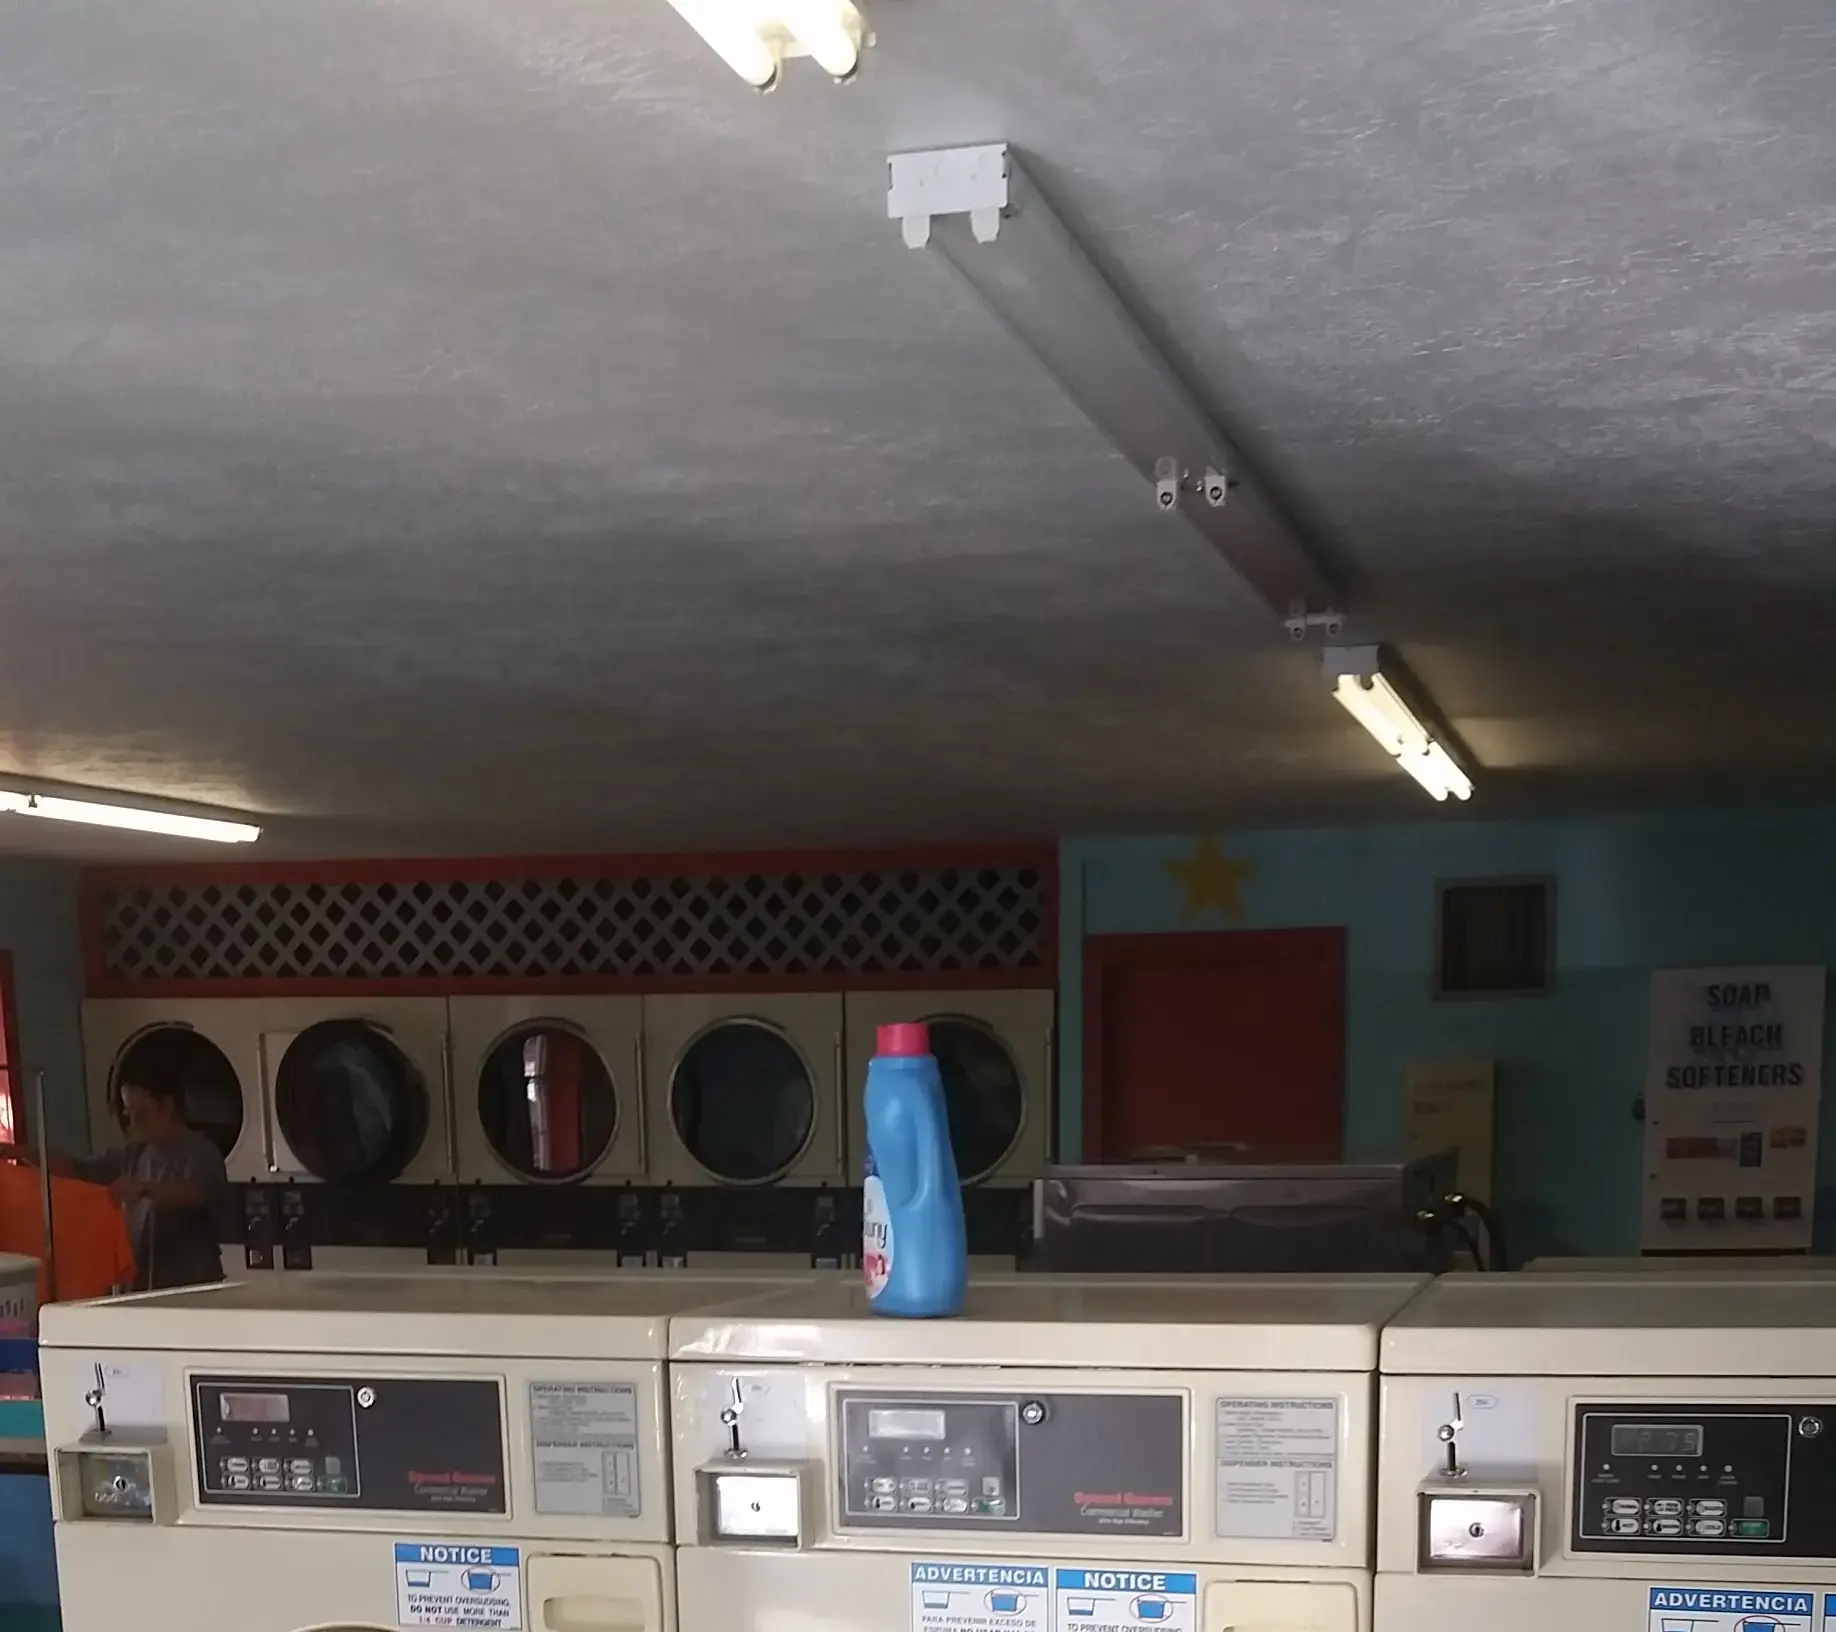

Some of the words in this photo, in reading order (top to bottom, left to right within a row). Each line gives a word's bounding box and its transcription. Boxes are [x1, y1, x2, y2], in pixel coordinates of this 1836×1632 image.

[1707, 983, 1770, 1007] SOAP
[1691, 1023, 1782, 1047] BLEACH
[1665, 1063, 1805, 1089] SOFTENERS
[420, 1546, 492, 1564] NOTICE
[915, 1566, 1044, 1584] ADVERTENCIA
[1084, 1572, 1166, 1590] NOTICE
[420, 1594, 453, 1604] PREVENT
[1654, 1592, 1808, 1612] ADVERTENCIA
[425, 1606, 442, 1614] NOT
[444, 1606, 459, 1614] USE
[464, 1607, 484, 1615] MORE
[489, 1608, 509, 1617] THAN
[456, 1618, 503, 1627] DETERGENT
[946, 1616, 987, 1625] PREVENIR
[989, 1618, 1022, 1627] EXCESO
[1025, 1620, 1036, 1628] DE
[1067, 1623, 1078, 1632] TO
